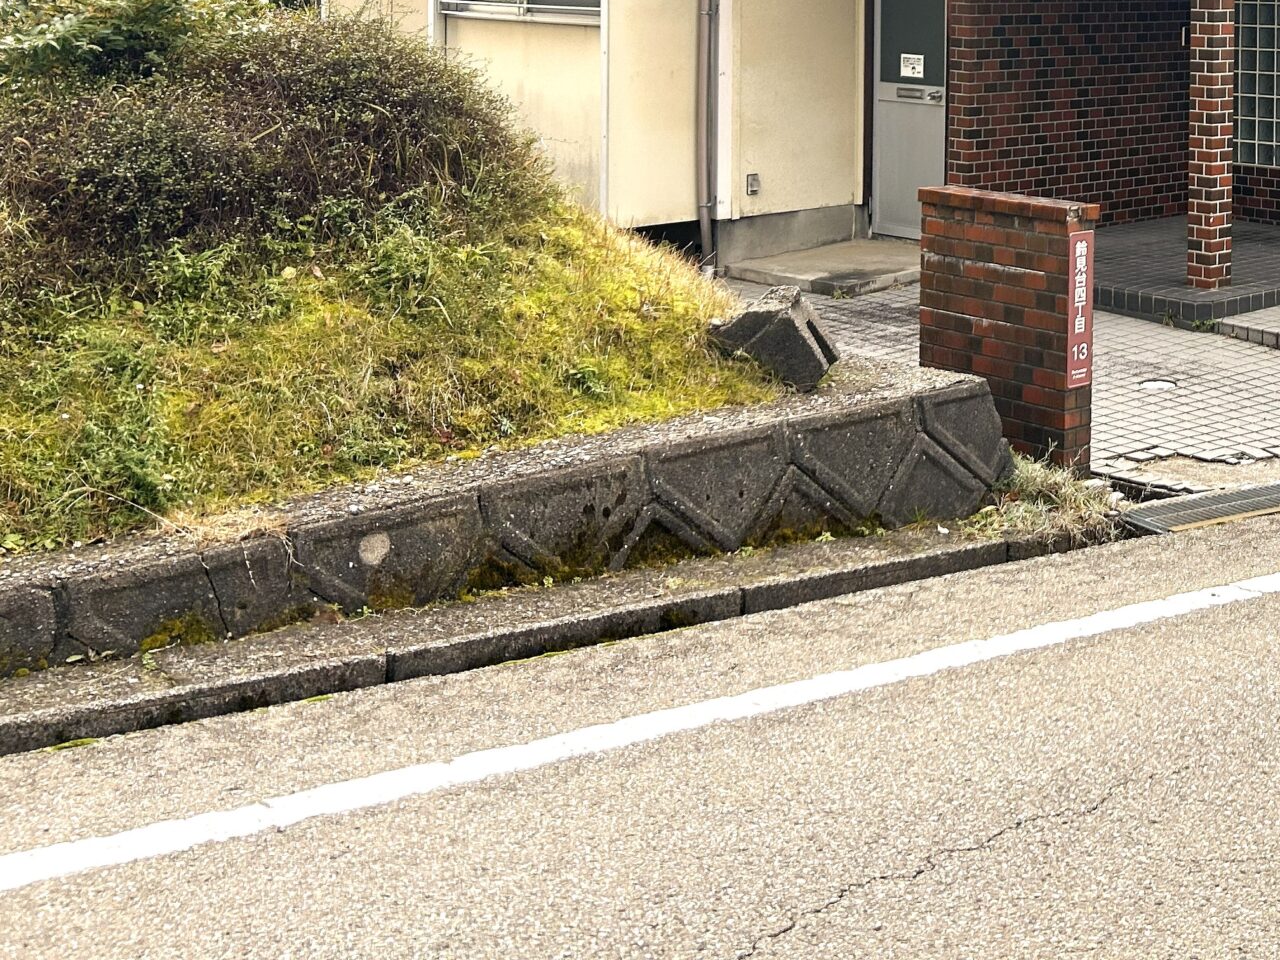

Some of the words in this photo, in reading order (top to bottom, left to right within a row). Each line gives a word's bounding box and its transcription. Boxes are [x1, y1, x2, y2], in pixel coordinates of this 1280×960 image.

[1074, 240, 1088, 334] 鈴見台四丁目
[1071, 343, 1088, 361] 13
